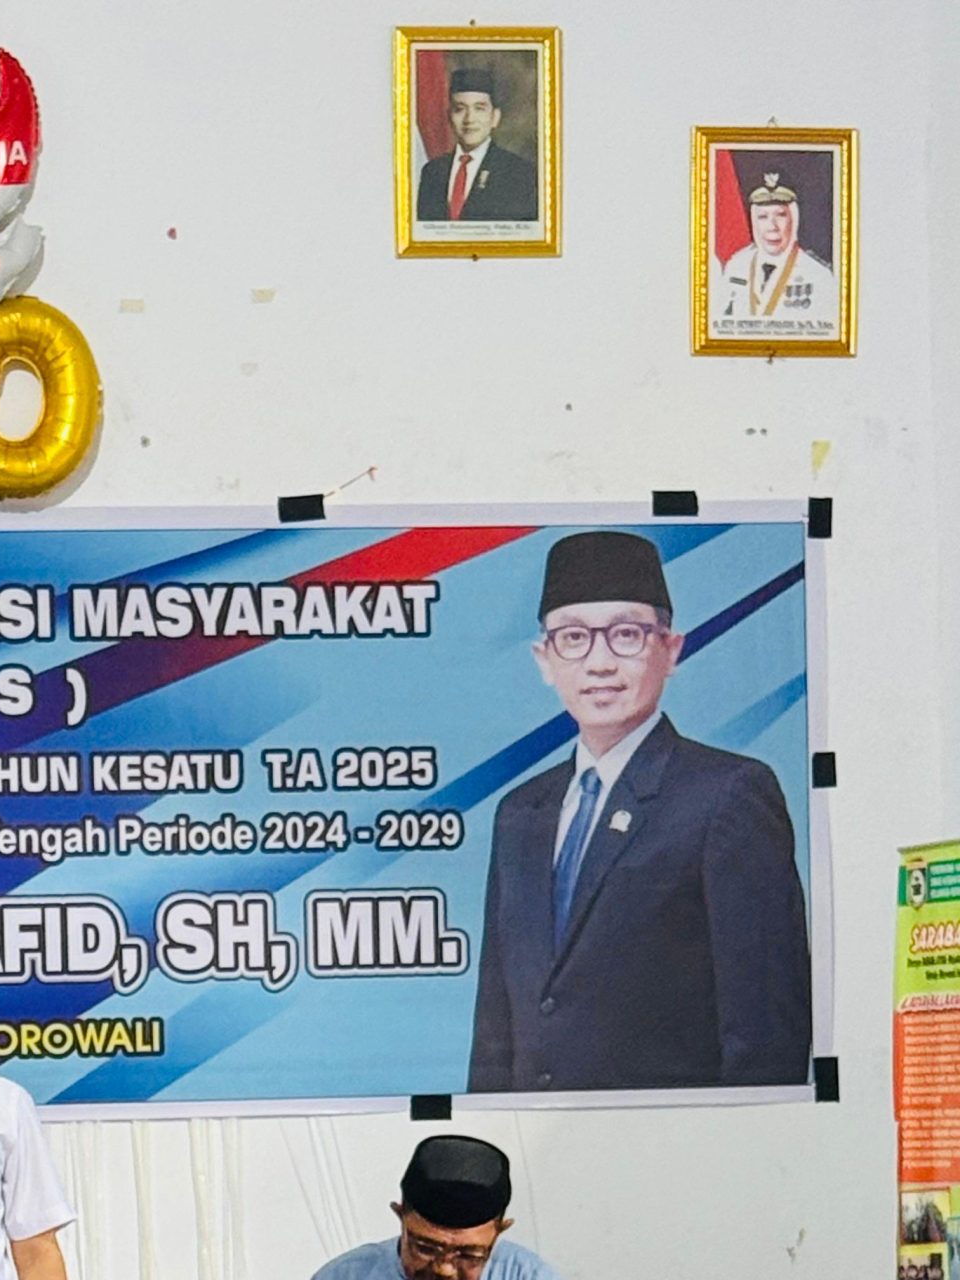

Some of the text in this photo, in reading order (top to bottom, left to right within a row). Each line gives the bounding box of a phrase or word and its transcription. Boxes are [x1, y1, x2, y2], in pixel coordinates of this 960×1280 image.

[72, 584, 437, 638] MASYARAKAT
[92, 752, 241, 792] KESATU
[264, 751, 324, 789] T.A
[335, 750, 435, 788] 2025
[118, 816, 253, 853] Periode
[263, 813, 347, 851] 2024
[378, 812, 462, 849] 2029
[159, 895, 294, 988] SH,
[309, 892, 465, 973] MM.
